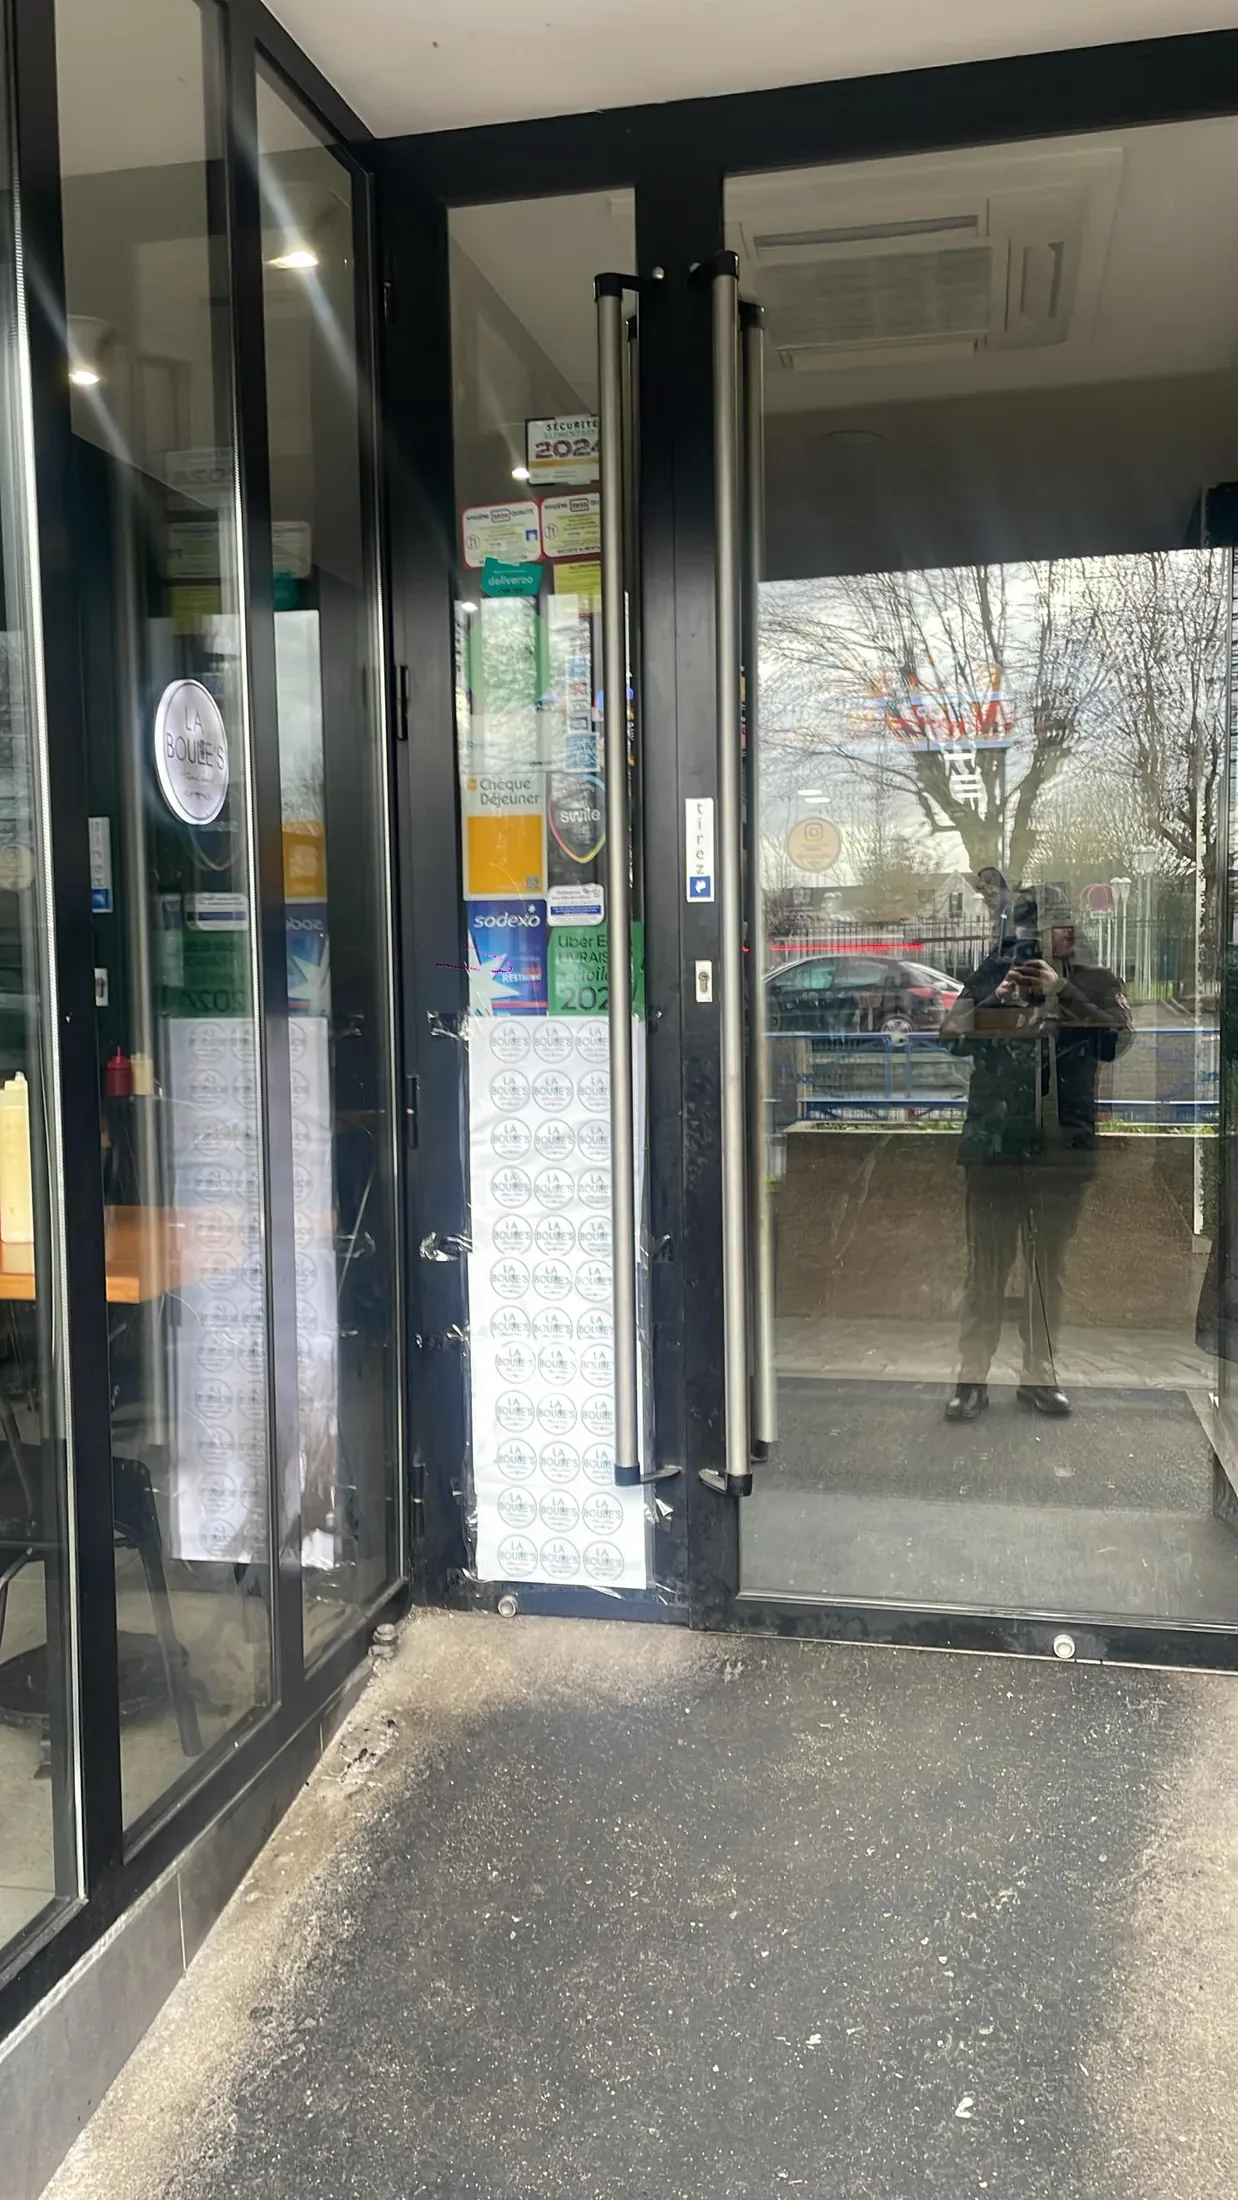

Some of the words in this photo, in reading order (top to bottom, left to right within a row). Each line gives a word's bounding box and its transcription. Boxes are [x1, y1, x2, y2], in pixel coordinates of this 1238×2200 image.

[547, 418, 599, 431] SÉCURITÉ
[488, 575, 534, 586] deliveroo
[184, 705, 204, 734] LA
[480, 776, 531, 792] Chèque
[480, 790, 540, 807] Déjeuner
[560, 806, 601, 823] swile
[473, 911, 541, 929] sodexo
[558, 935, 593, 949] Uber
[503, 1028, 515, 1037] LA
[547, 1028, 558, 1037] LA
[590, 1028, 602, 1037] LA
[504, 1076, 516, 1085] LA
[545, 1077, 558, 1085] LA
[591, 1076, 604, 1086] LA
[505, 1124, 517, 1133] LA
[548, 1125, 560, 1134] LA
[591, 1126, 603, 1135] LA
[505, 1173, 517, 1182] LA
[547, 1175, 560, 1184] LA
[591, 1175, 603, 1184] LA
[506, 1221, 517, 1230] LA
[548, 1223, 560, 1231] LA
[592, 1222, 604, 1231] LA
[503, 1264, 515, 1273] LA
[545, 1266, 557, 1274] LA
[589, 1267, 601, 1276] LA
[504, 1313, 516, 1322] LA
[546, 1314, 558, 1323] LA
[590, 1316, 602, 1324] LA
[509, 1348, 521, 1357] LA
[551, 1350, 563, 1359] LA
[594, 1351, 606, 1359] LA
[508, 1398, 518, 1406] LA
[550, 1400, 562, 1408] LA
[594, 1401, 606, 1410] LA
[510, 1446, 522, 1454] LA
[553, 1448, 565, 1457] LA
[596, 1450, 608, 1458] LA
[510, 1494, 522, 1502] LA
[552, 1497, 564, 1505] LA
[596, 1499, 608, 1508] LA
[511, 1542, 524, 1550] LA
[553, 1545, 565, 1553] LA
[596, 1548, 608, 1557] LA
